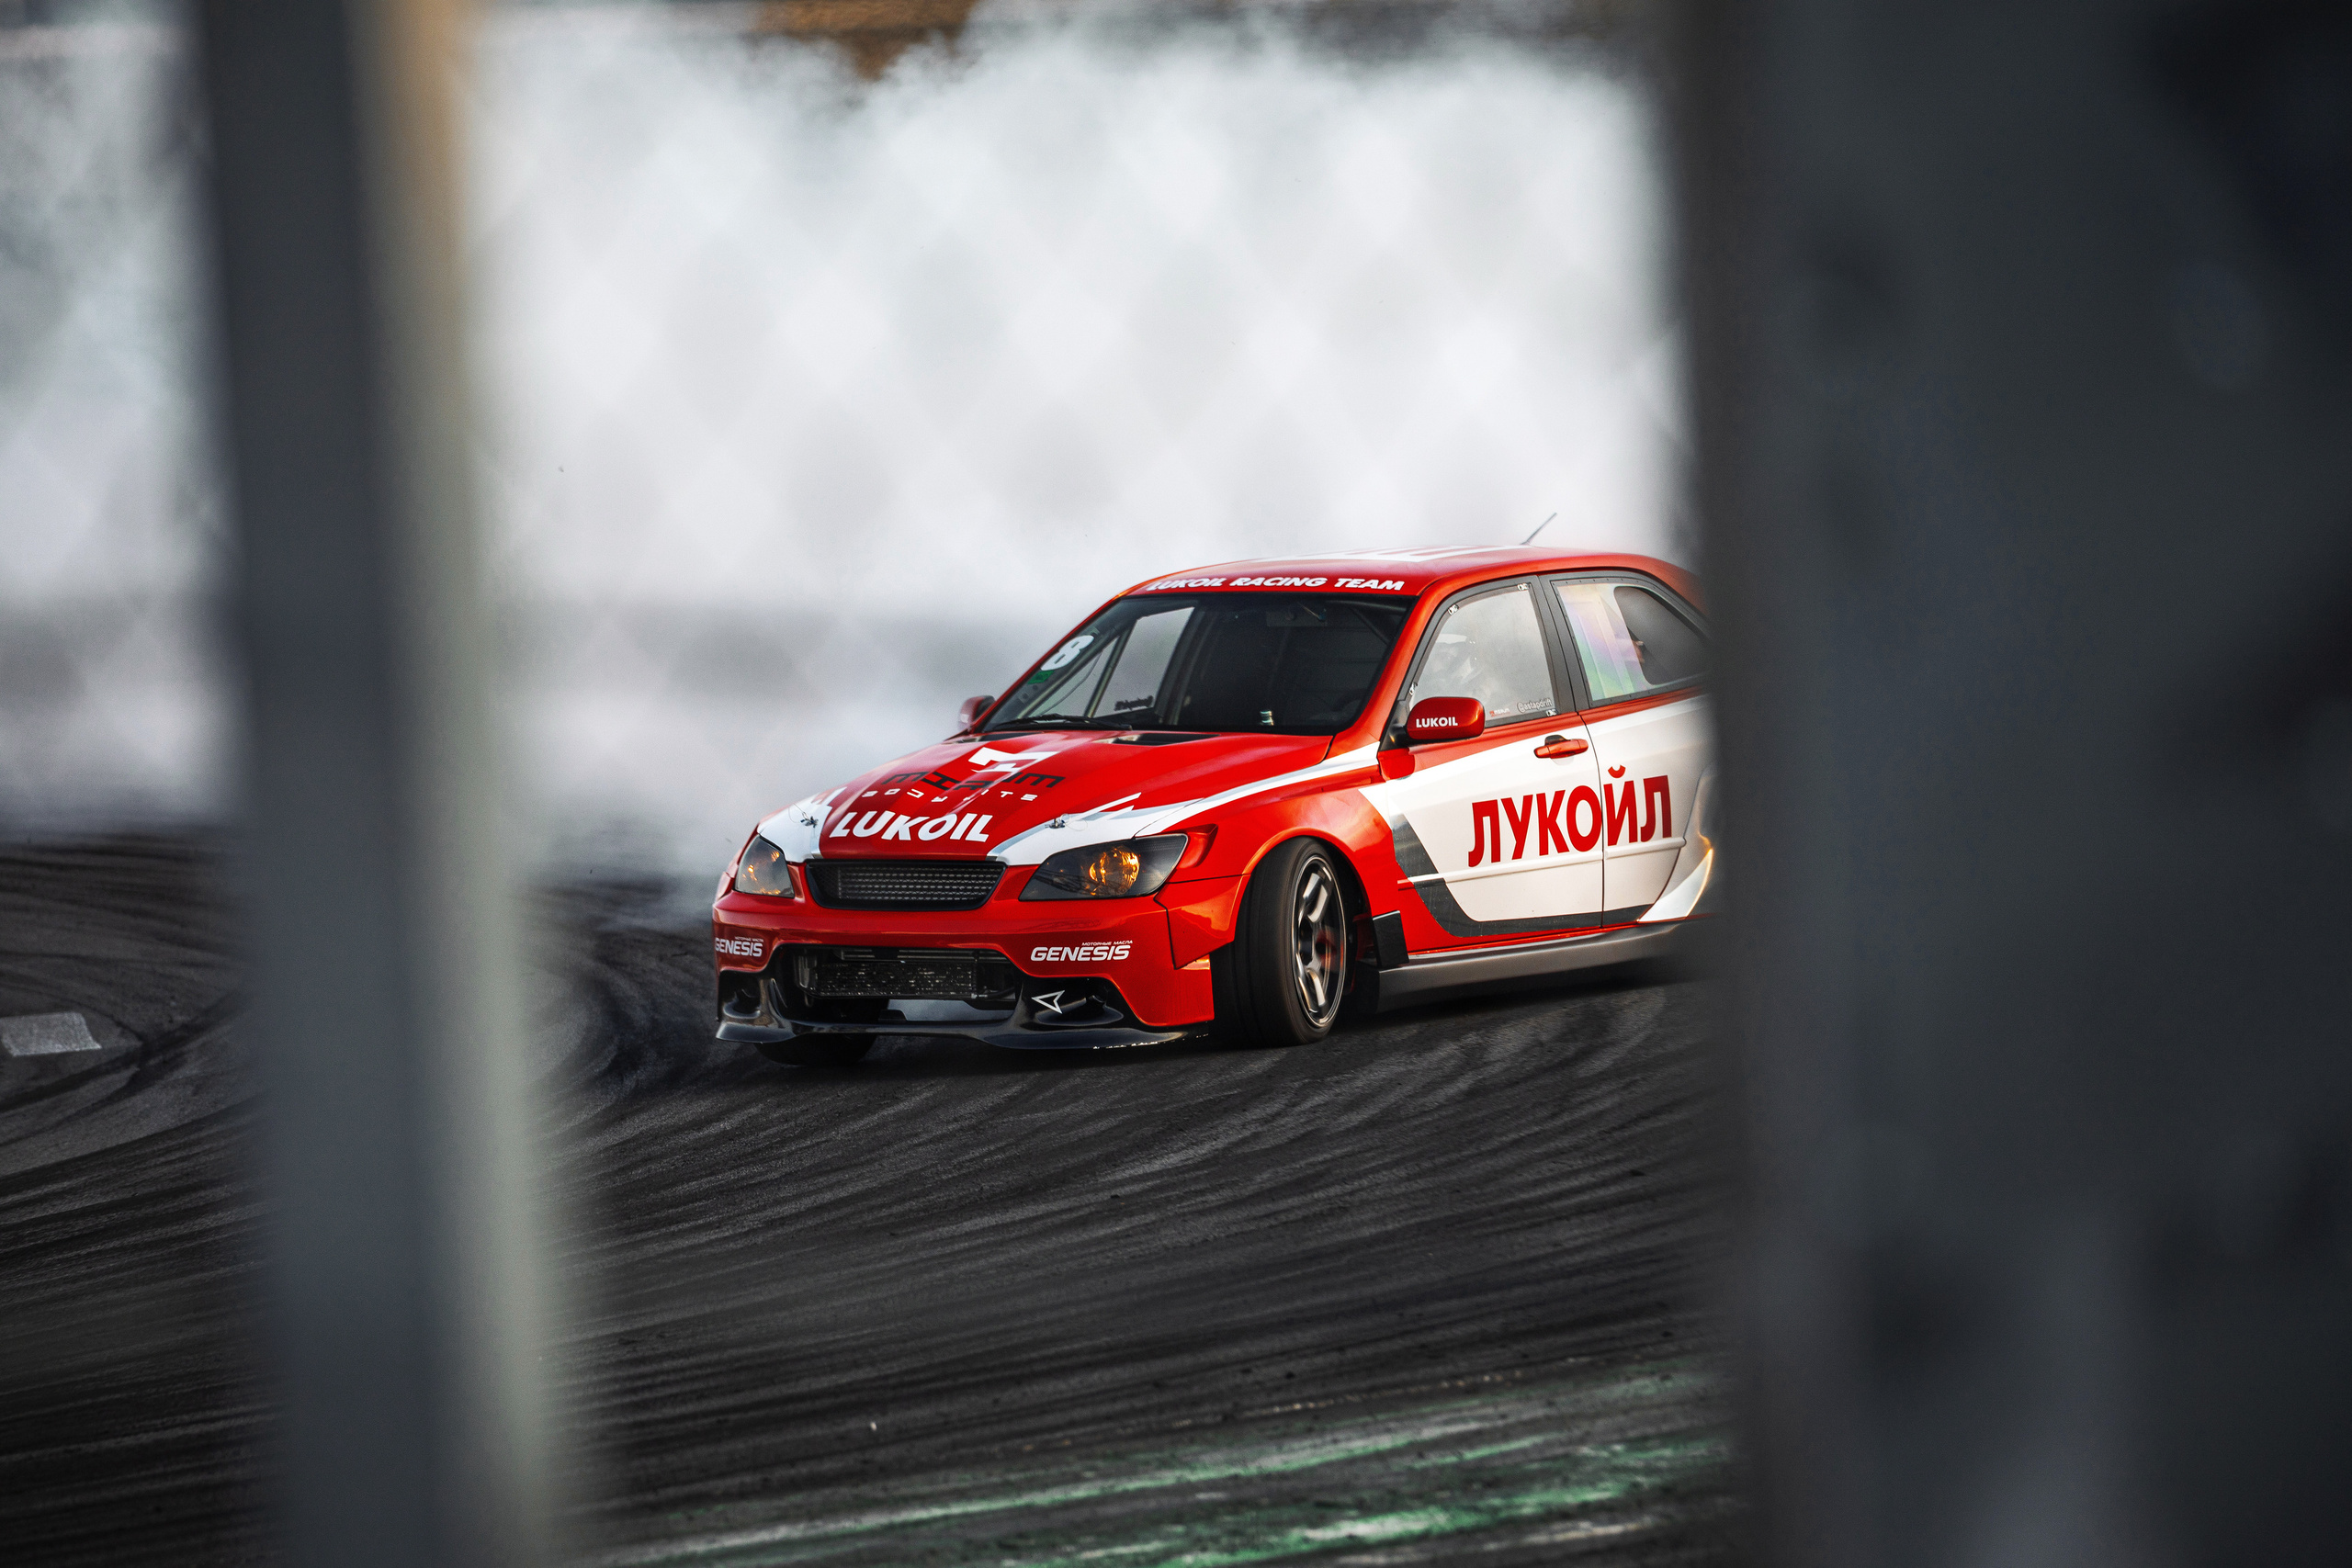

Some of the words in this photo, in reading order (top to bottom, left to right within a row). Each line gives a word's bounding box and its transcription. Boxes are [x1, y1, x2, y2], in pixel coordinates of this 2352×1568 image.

[1148, 578, 1226, 591] LUKOIL
[1229, 577, 1328, 587] RACING
[1334, 578, 1405, 591] TEAM
[1040, 635, 1094, 671] 8
[1416, 716, 1458, 728] LUKOIL
[830, 810, 993, 842] LUKOIL
[1468, 764, 1672, 867] ЛУКОЙЛ
[1030, 945, 1131, 961] GENESIS
